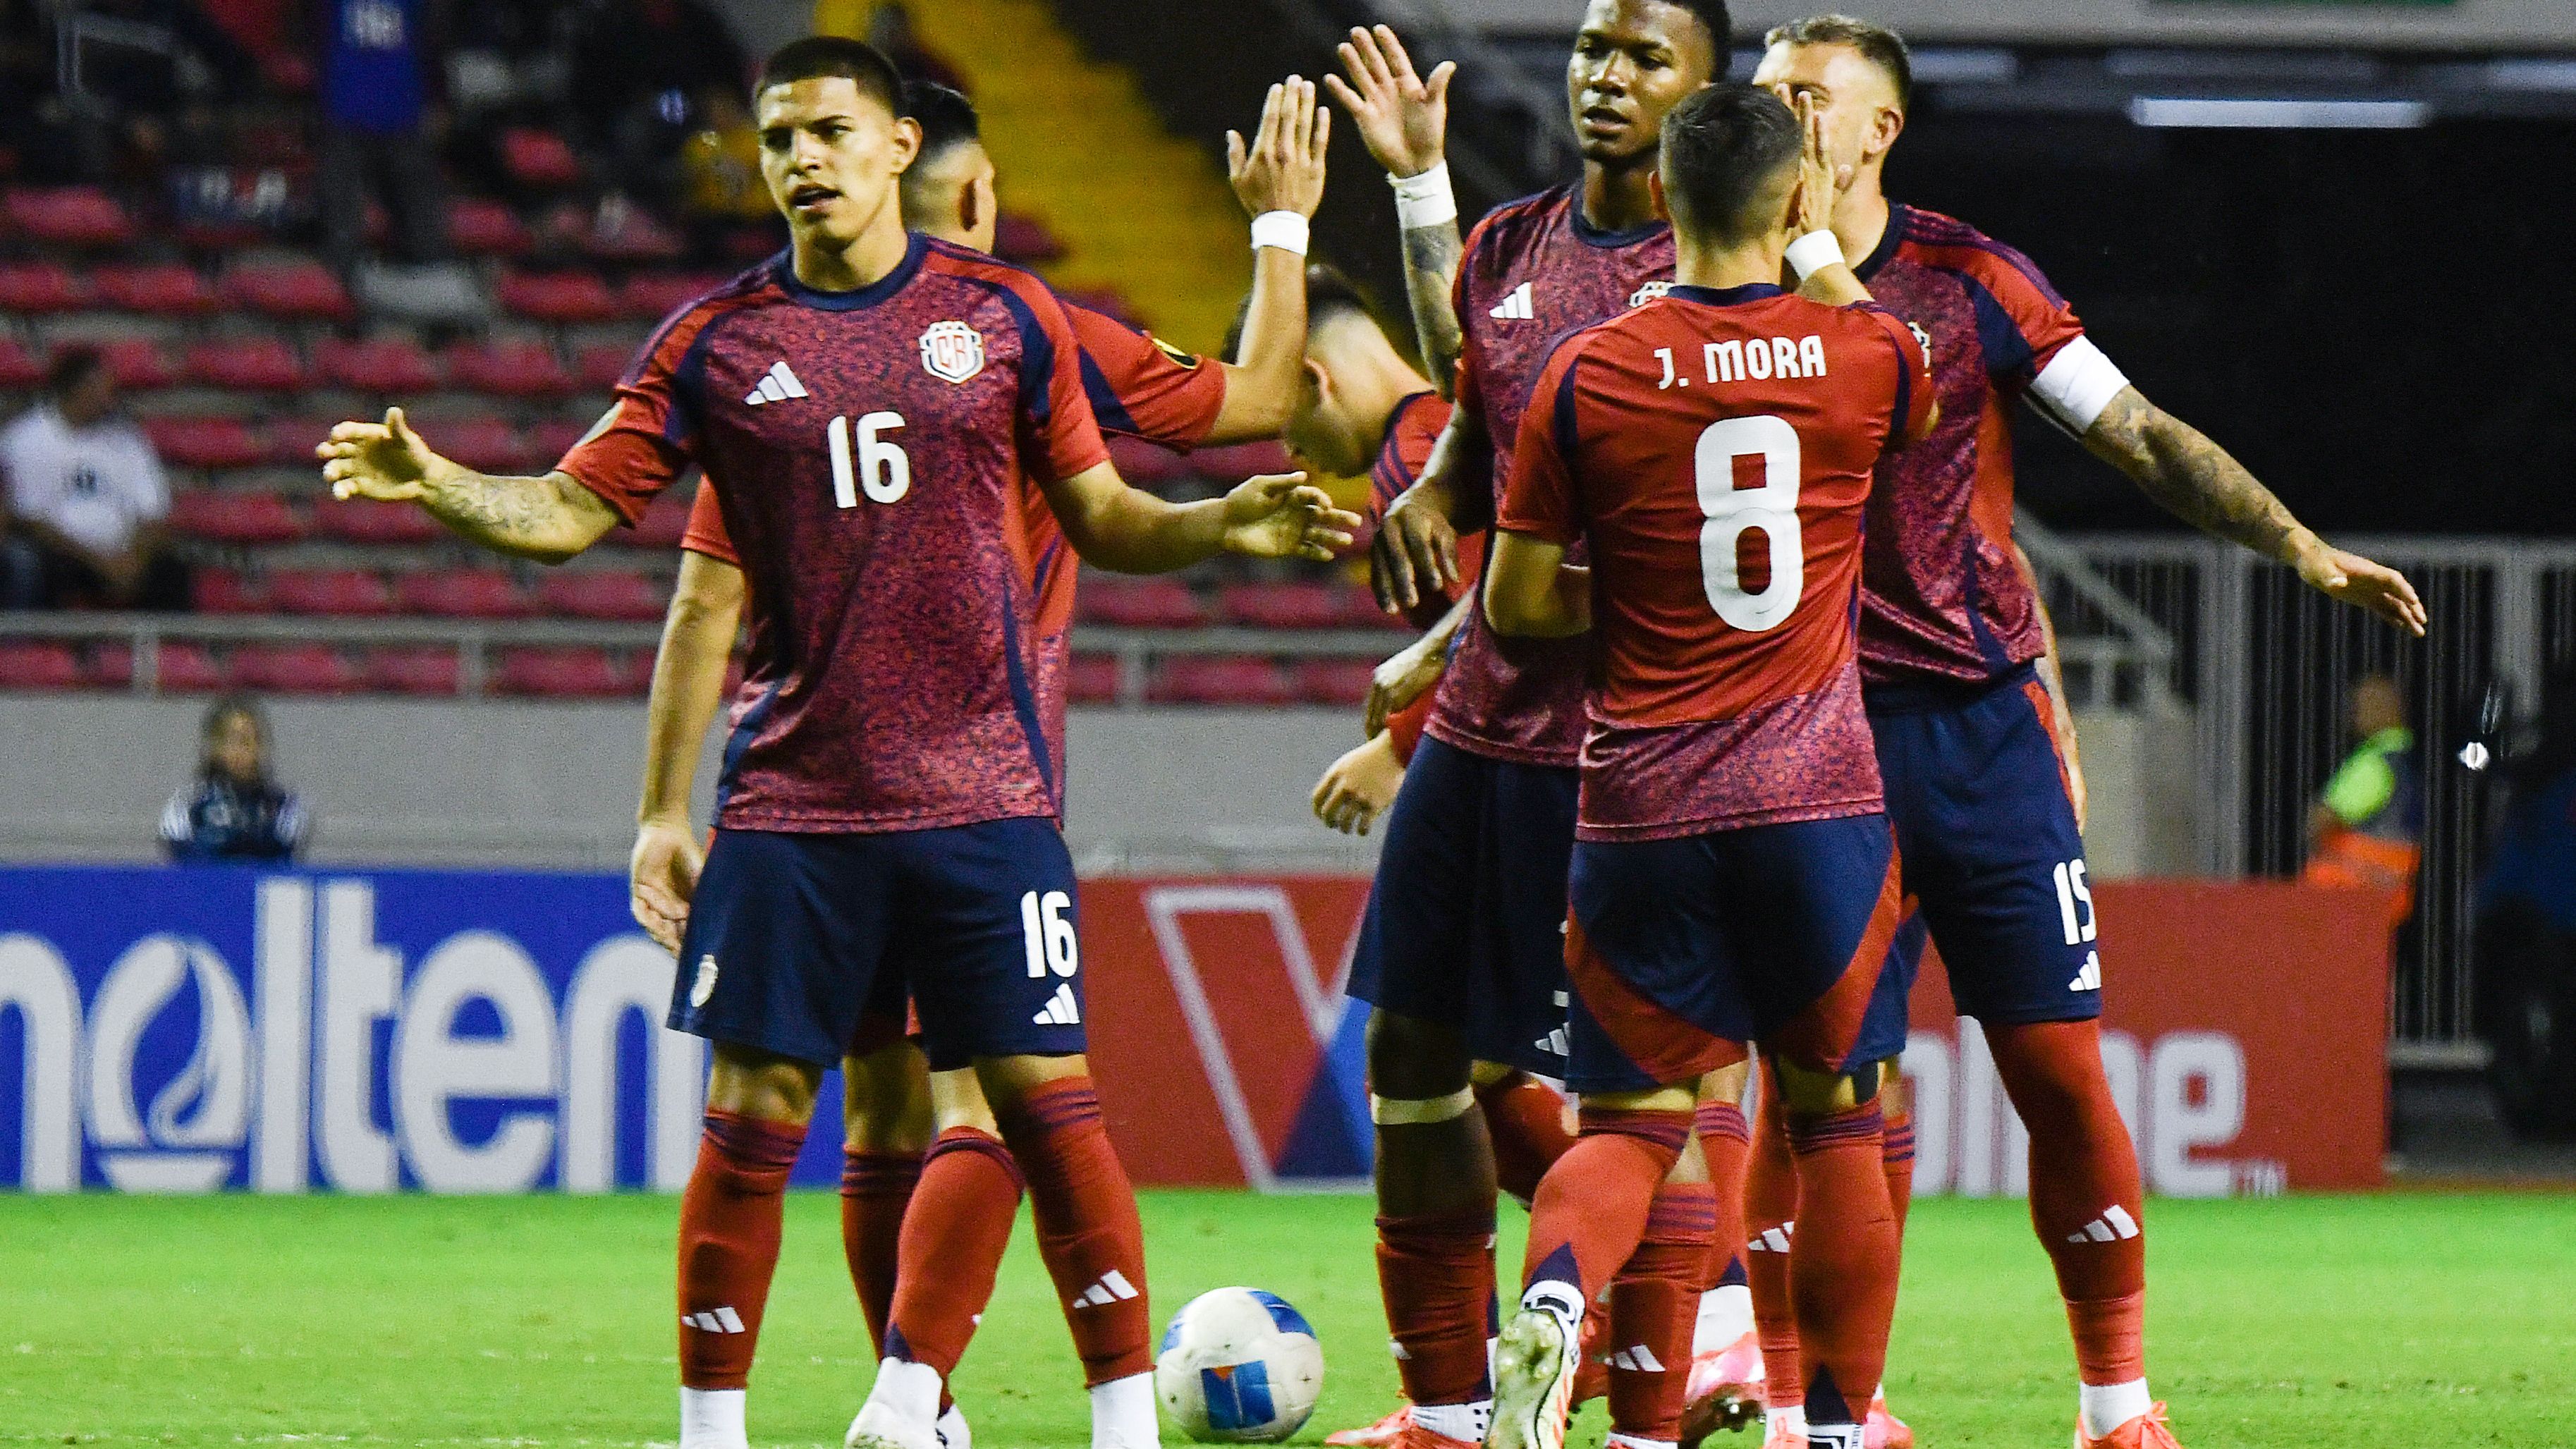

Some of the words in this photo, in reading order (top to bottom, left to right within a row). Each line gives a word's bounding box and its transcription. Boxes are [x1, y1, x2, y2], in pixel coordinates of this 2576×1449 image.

[1654, 348, 1690, 390] J.
[1704, 335, 1827, 384] MORA
[827, 411, 910, 508] 16
[1695, 415, 1803, 632] 8
[1020, 891, 1078, 978] 16
[2053, 858, 2096, 945] 15
